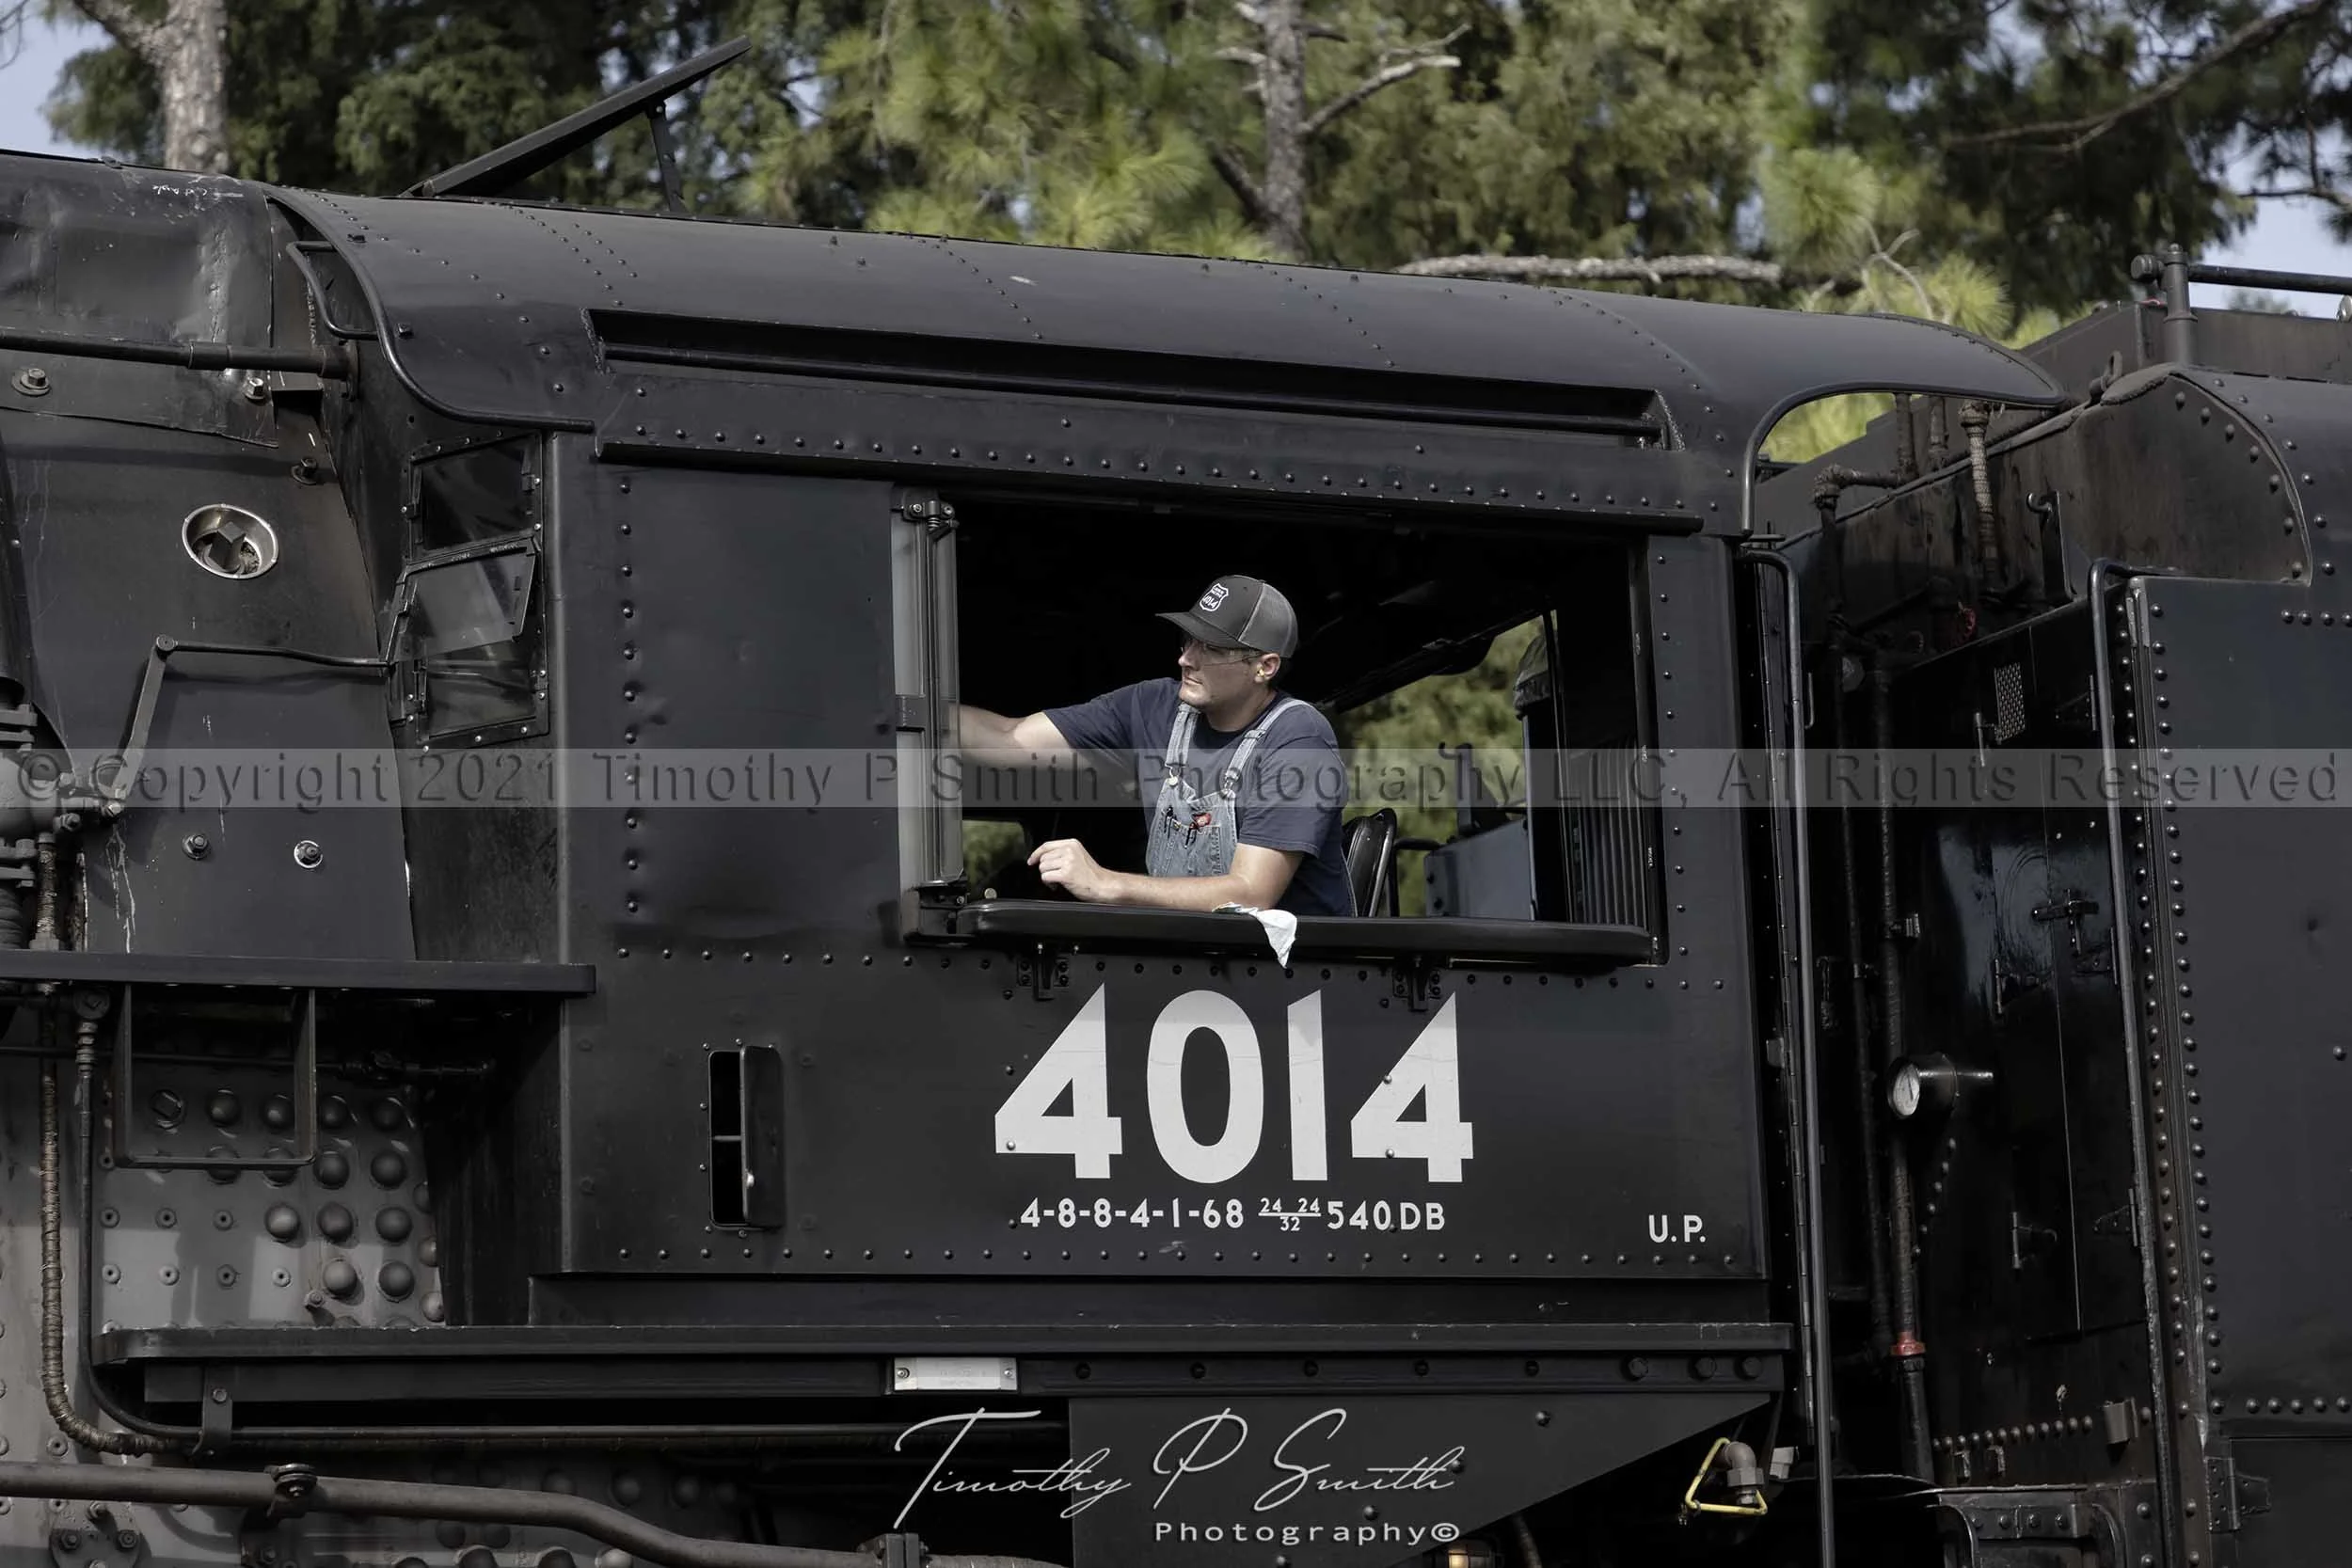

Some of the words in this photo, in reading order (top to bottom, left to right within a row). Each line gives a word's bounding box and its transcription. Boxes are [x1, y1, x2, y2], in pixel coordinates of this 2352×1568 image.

[994, 983, 1473, 1183] 4014
[1021, 1197, 1244, 1228] 4-8-8-4-1-68
[1649, 1215, 1706, 1243] U.P.
